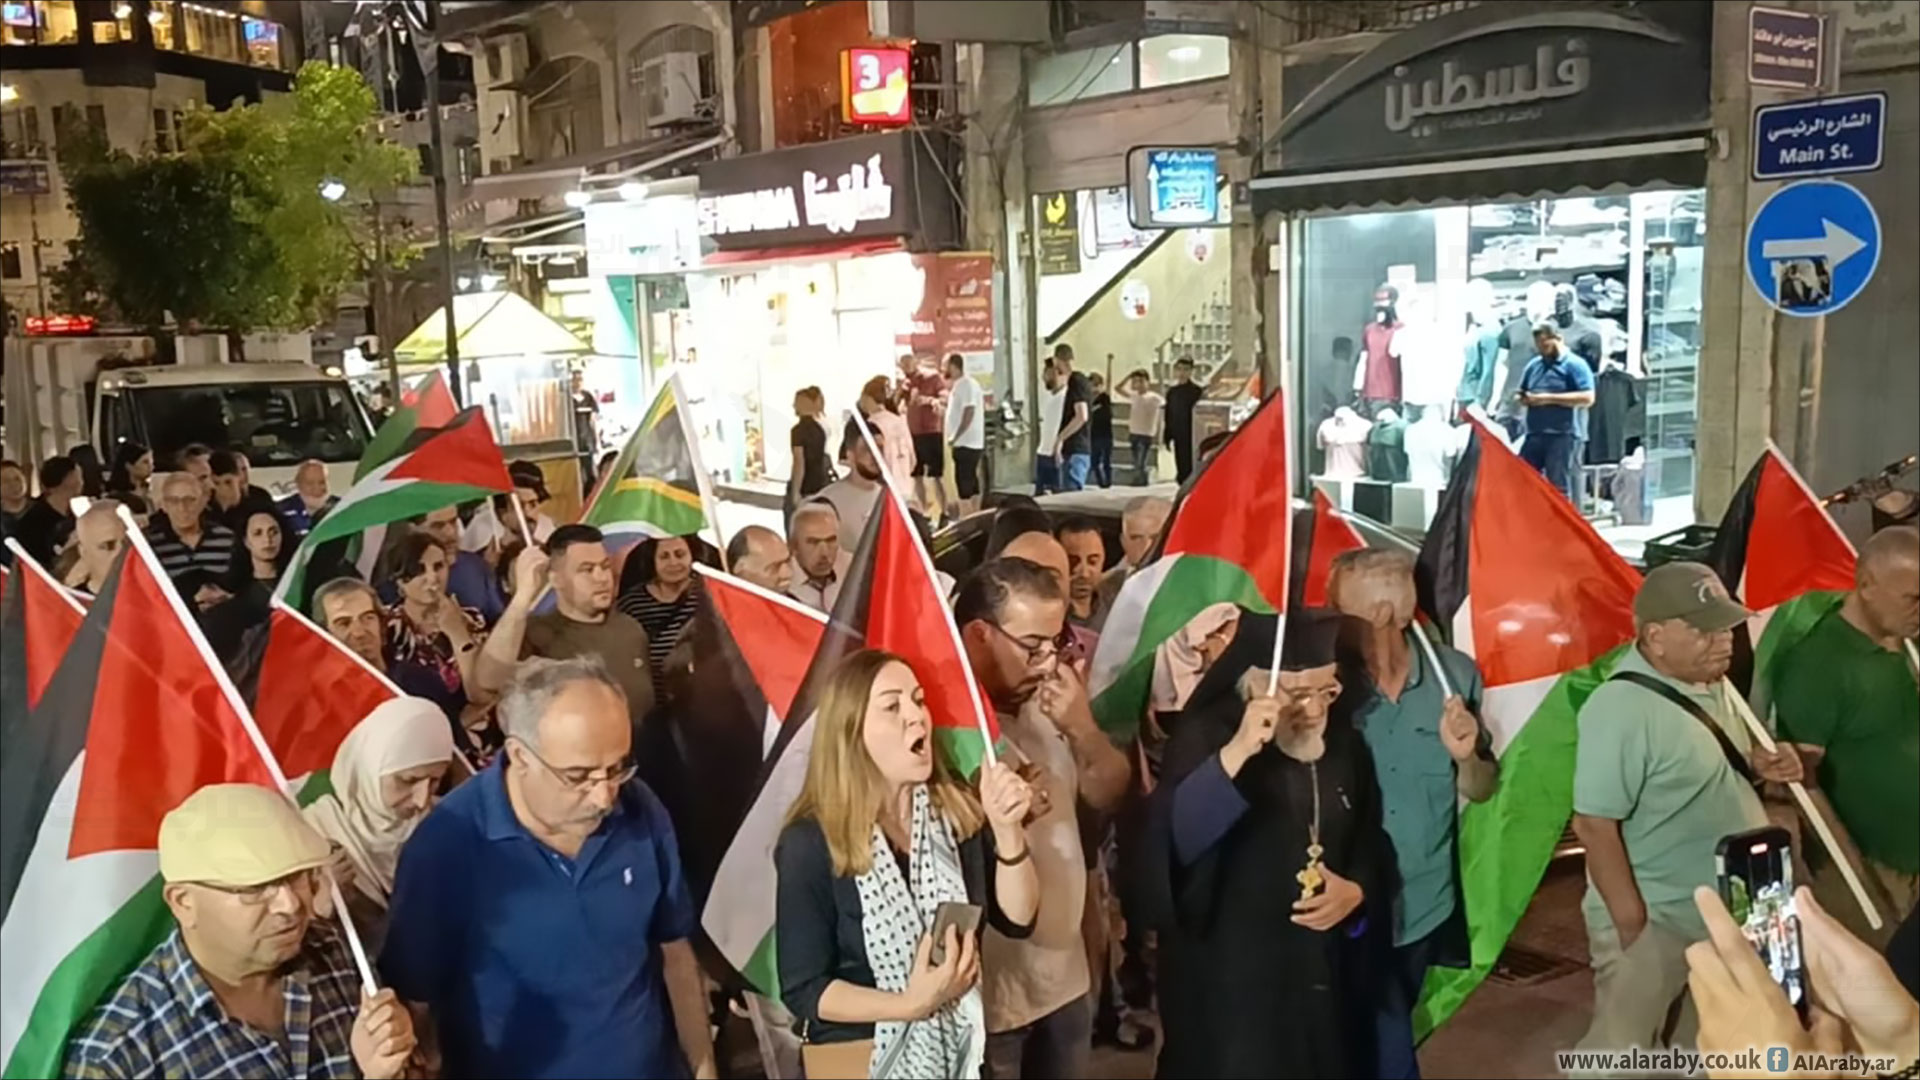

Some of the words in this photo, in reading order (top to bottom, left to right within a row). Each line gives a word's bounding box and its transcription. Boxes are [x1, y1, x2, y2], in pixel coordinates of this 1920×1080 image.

[858, 54, 881, 90] 3
[1384, 38, 1592, 137] فلسطين
[1767, 117, 1825, 142] الرئيسي
[1825, 113, 1872, 137] الشارع
[1778, 145, 1825, 165] Main
[1829, 143, 1854, 160] St.
